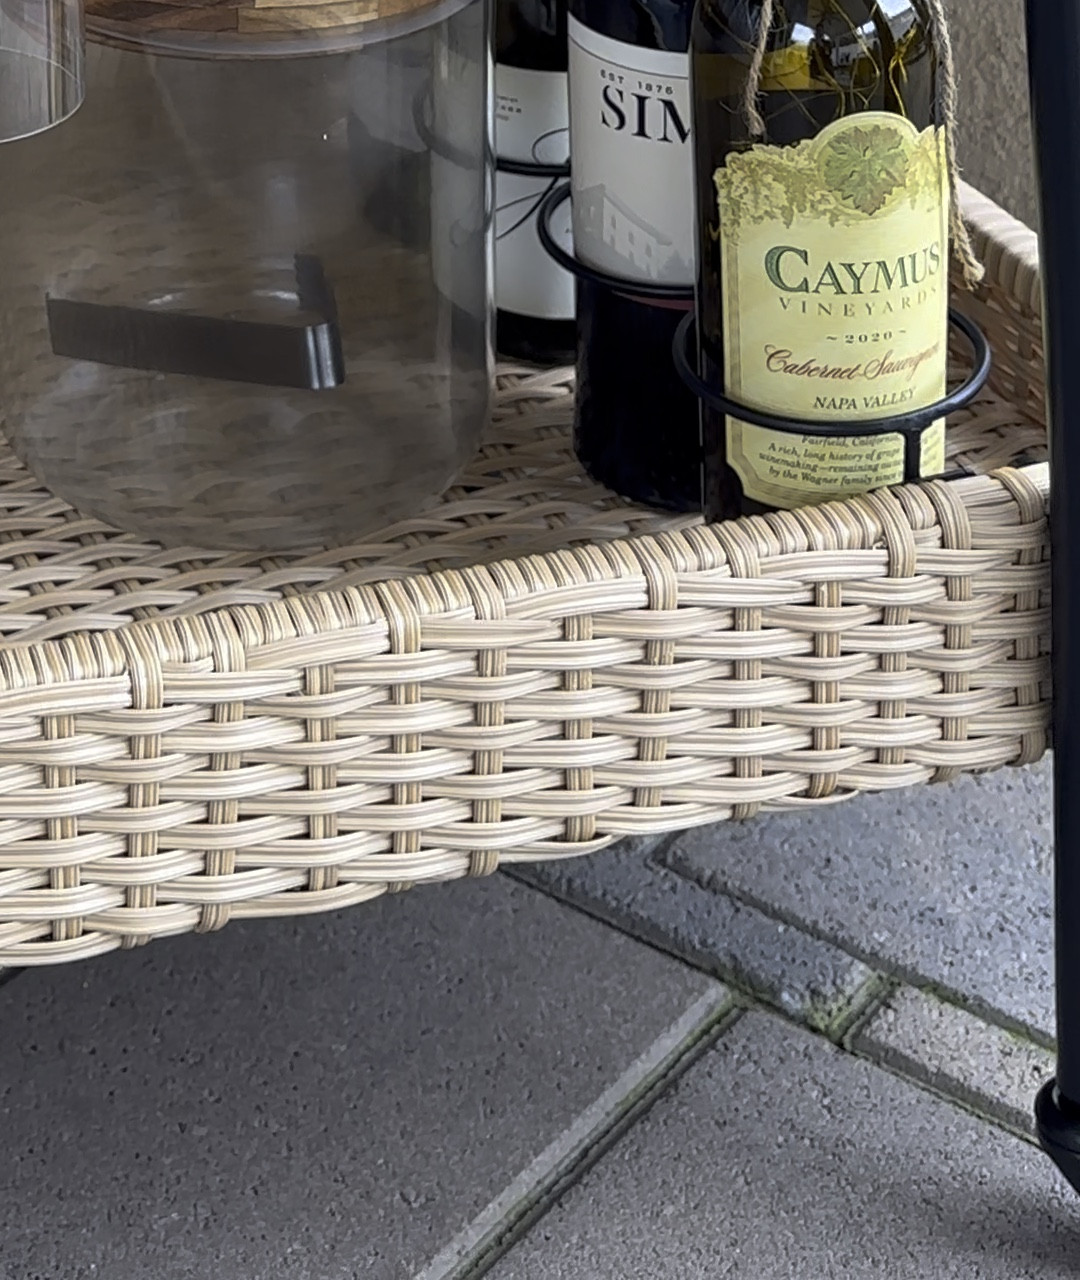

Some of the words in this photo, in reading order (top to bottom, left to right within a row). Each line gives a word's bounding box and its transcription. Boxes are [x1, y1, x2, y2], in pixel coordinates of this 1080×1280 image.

[600, 68, 624, 84] EST
[638, 81, 673, 95] 1876
[765, 241, 940, 295] CAYMUS
[779, 286, 937, 317] VINEYARDS
[764, 344, 862, 380] Cabernet
[813, 395, 857, 410] NAPA
[863, 386, 918, 409] VALLEY
[768, 442, 777, 452] A
[829, 451, 863, 461] history
